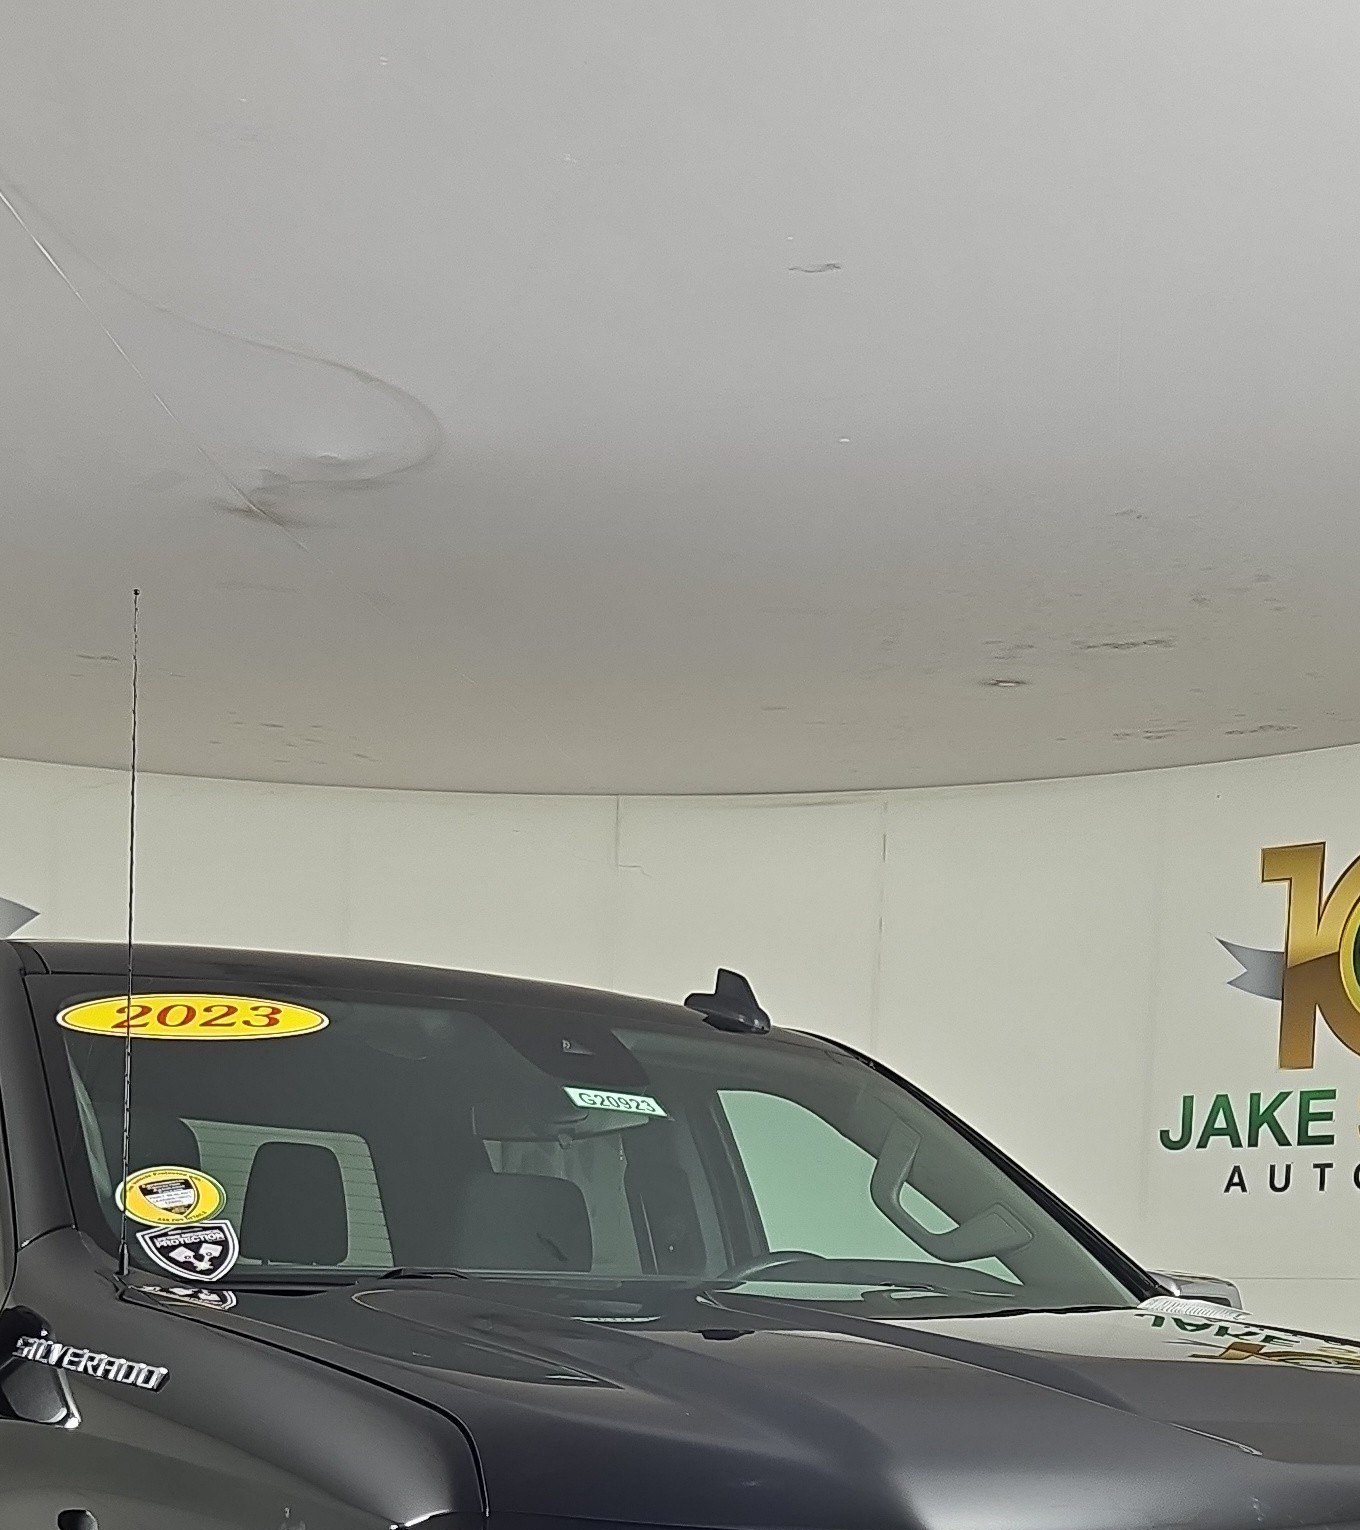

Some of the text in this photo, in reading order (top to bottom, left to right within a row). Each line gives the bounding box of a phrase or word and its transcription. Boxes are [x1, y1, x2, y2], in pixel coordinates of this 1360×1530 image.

[110, 1003, 282, 1031] 2023
[579, 1092, 656, 1113] G20923
[1160, 1088, 1337, 1151] JAKE
[12, 1336, 170, 1390] SILVERADO
